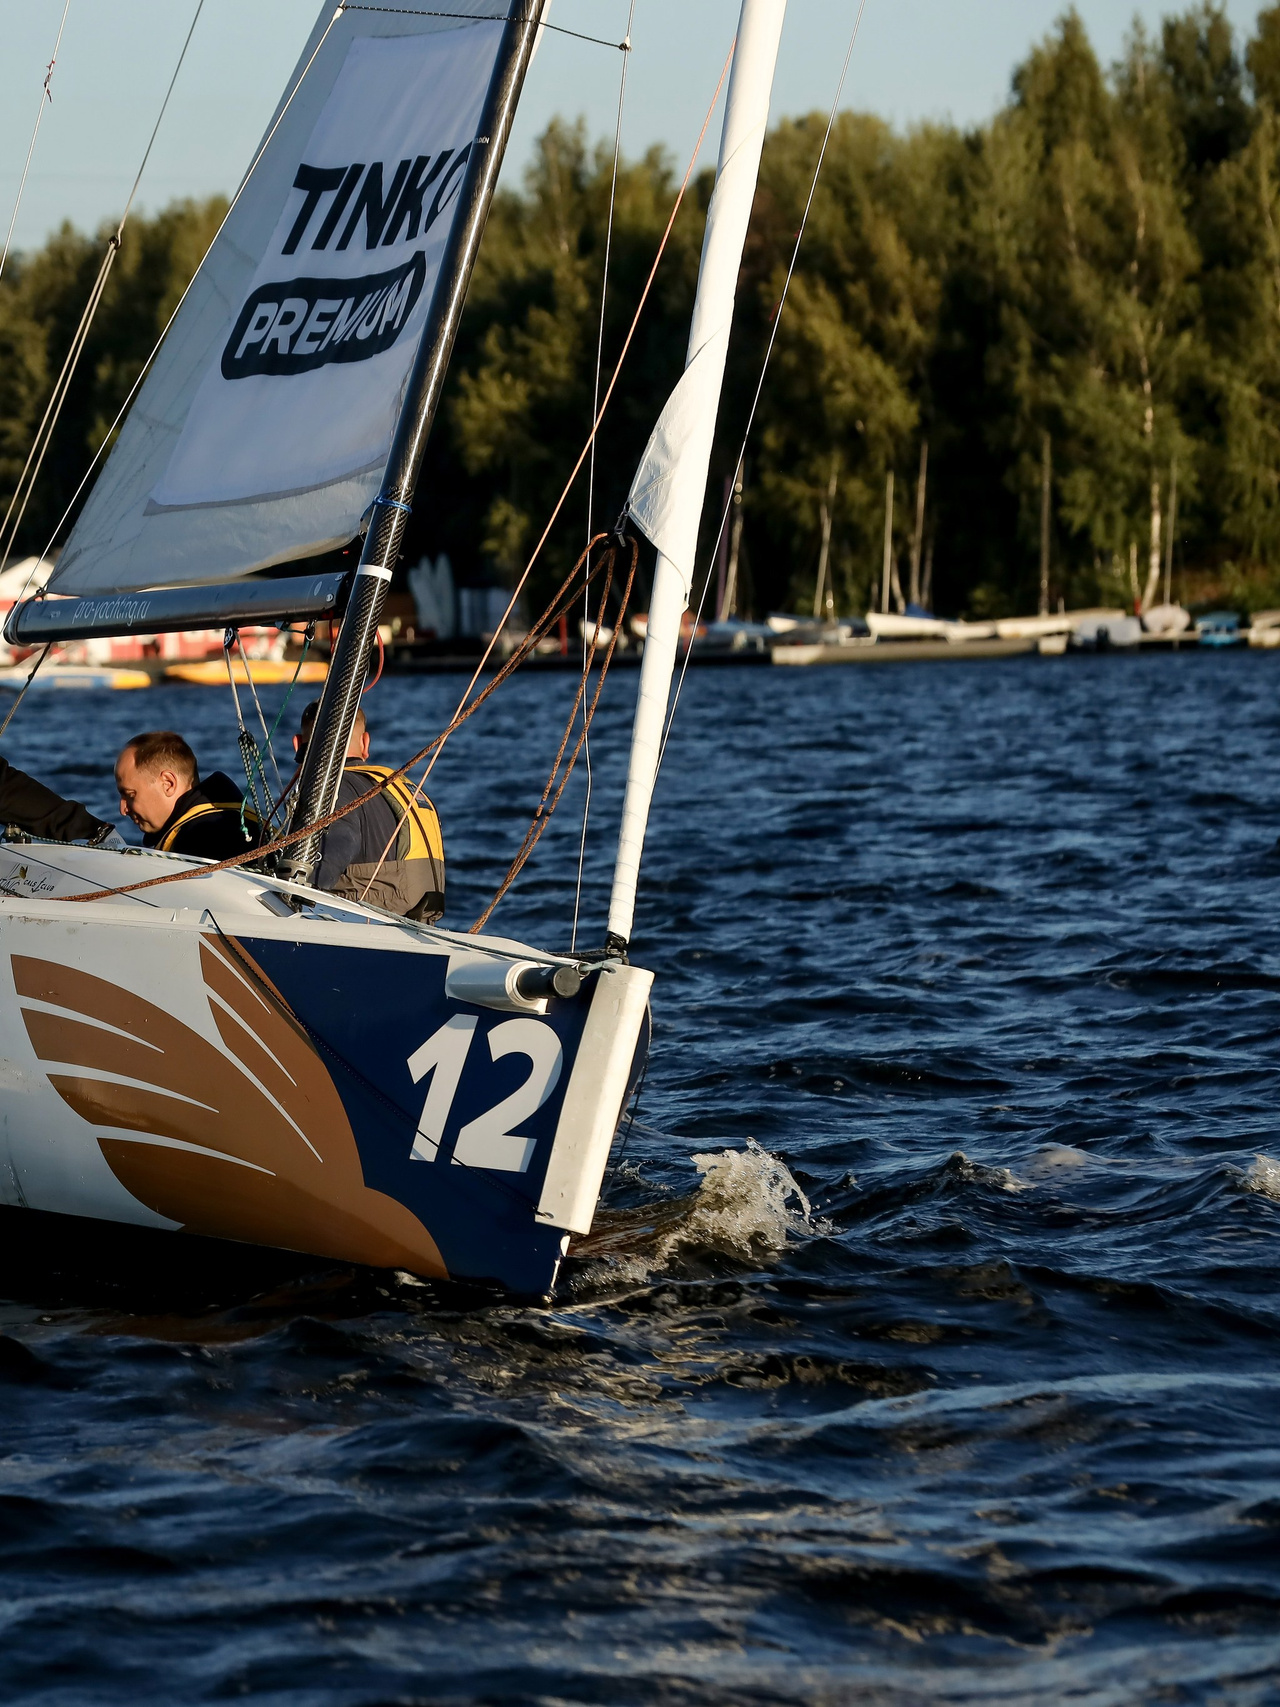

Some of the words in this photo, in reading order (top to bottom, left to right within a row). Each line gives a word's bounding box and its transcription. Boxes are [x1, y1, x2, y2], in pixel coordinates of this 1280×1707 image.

[234, 268, 417, 359] PREMIUM
[72, 597, 151, 626] pro-yachting.ru
[406, 1013, 564, 1173] 12
